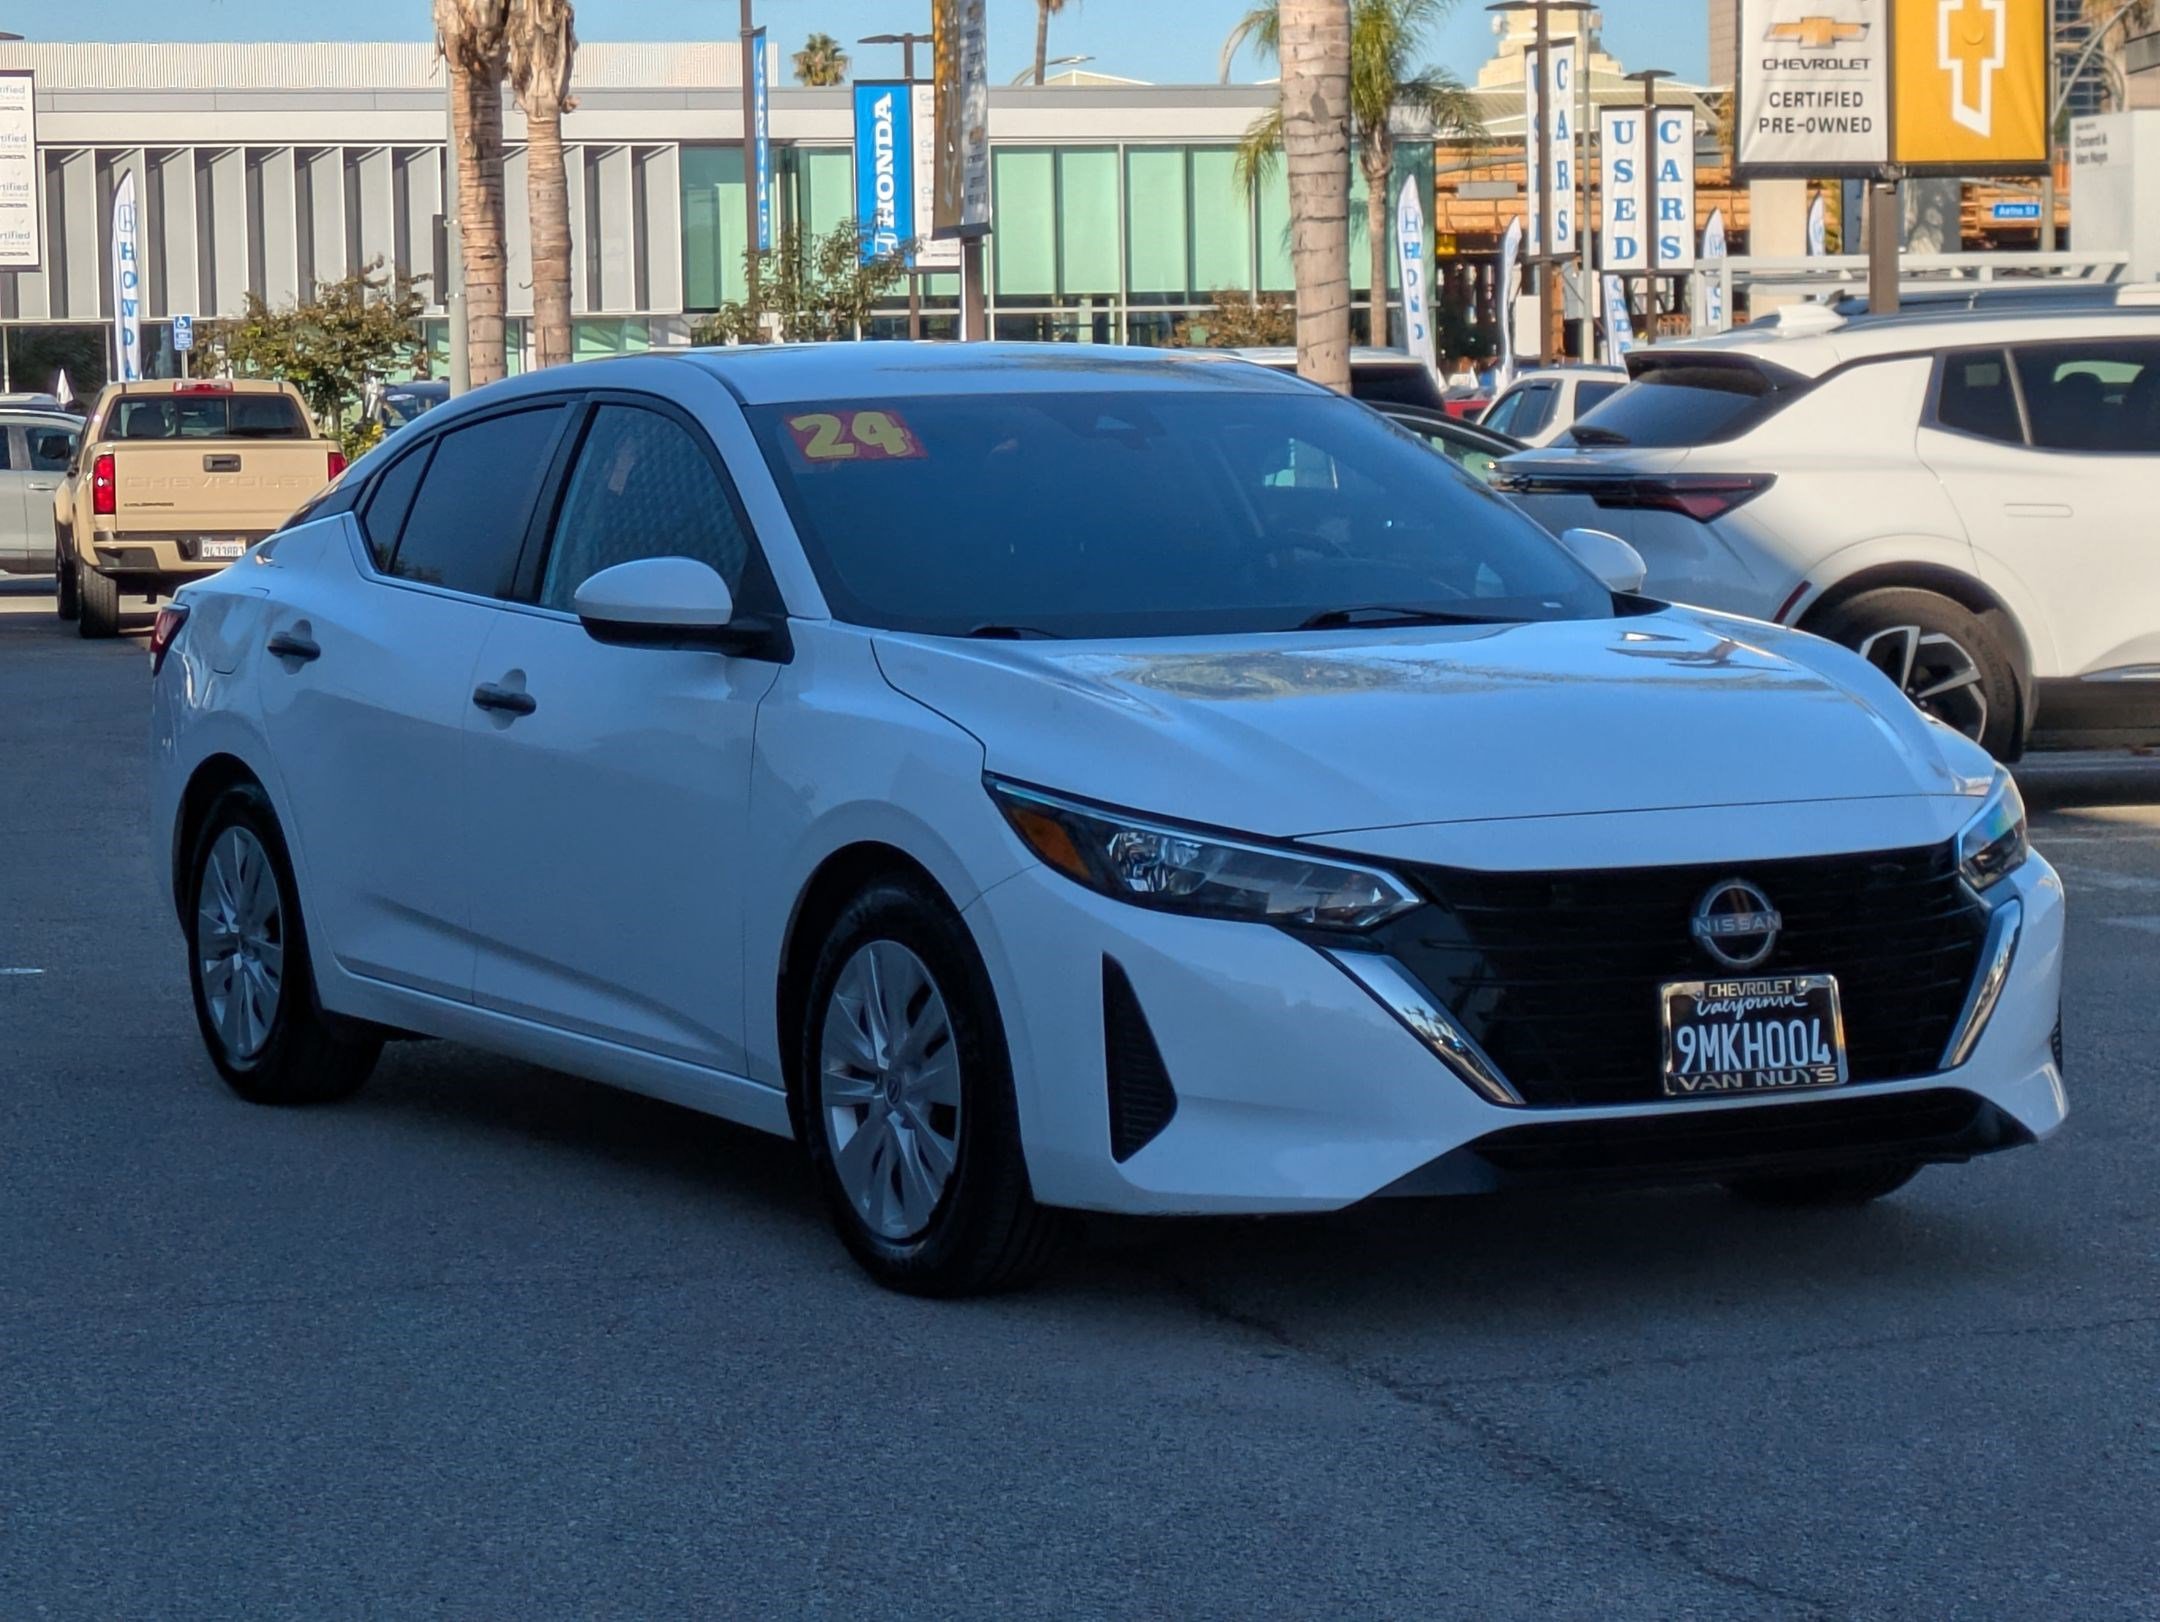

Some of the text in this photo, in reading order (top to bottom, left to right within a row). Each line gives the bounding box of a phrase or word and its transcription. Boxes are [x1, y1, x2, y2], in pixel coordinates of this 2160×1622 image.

[1761, 58, 1872, 71] CHEVROLET
[1768, 91, 1864, 108] CERTIFIED
[1759, 117, 1873, 134] PRE-OWNED
[874, 92, 896, 229] HONDA
[1555, 58, 1570, 241] CARS
[1612, 120, 1638, 261] USED
[1657, 119, 1686, 260] CARS
[789, 410, 909, 458] 24
[127, 475, 319, 489] CHEVROLET
[1695, 914, 1780, 933] NISSAN
[1708, 980, 1793, 998] CHEVROLET
[1696, 993, 1809, 1021] California
[1676, 1018, 1832, 1074] 9MKH004
[1678, 1066, 1837, 1091] VAN NUYS
